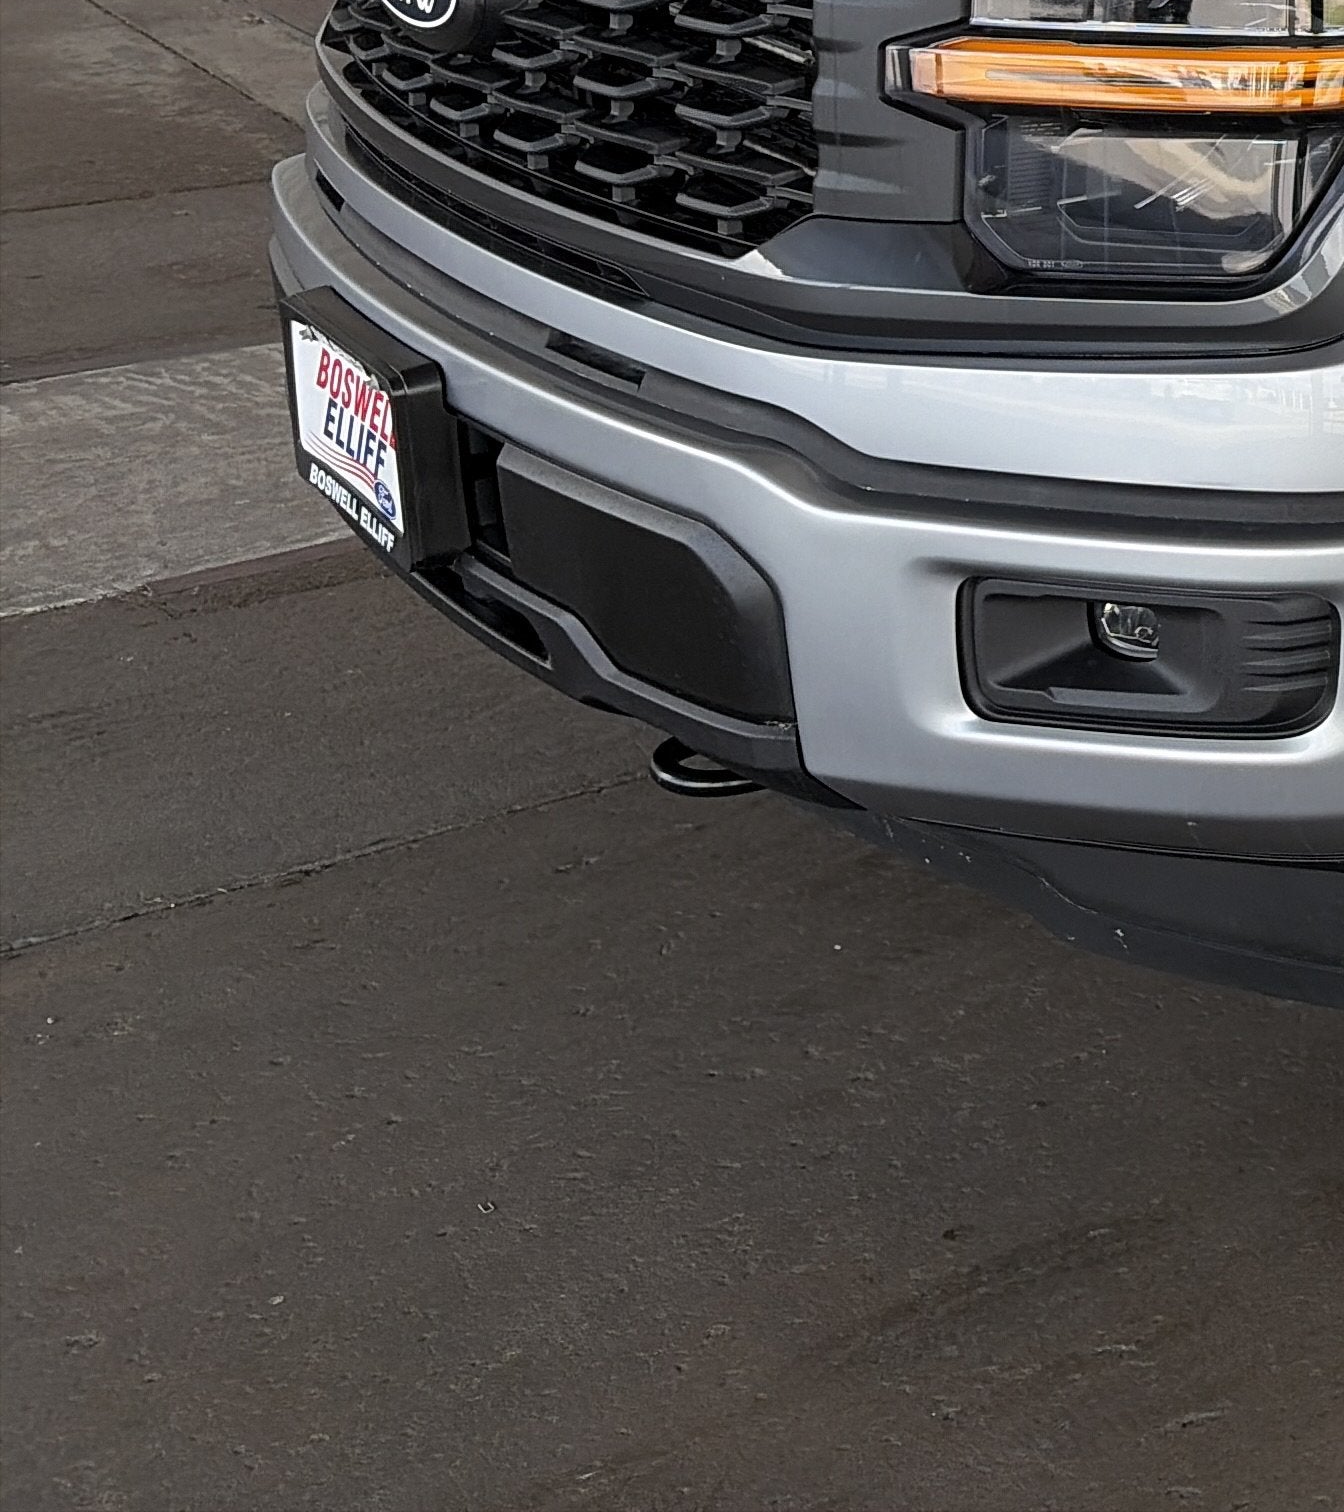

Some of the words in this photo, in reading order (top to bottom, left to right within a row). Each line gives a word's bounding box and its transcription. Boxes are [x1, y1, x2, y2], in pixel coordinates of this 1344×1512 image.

[323, 397, 388, 480] ELLIFF
[308, 462, 359, 521] BOSWELL
[360, 505, 395, 553] ELLIFF
